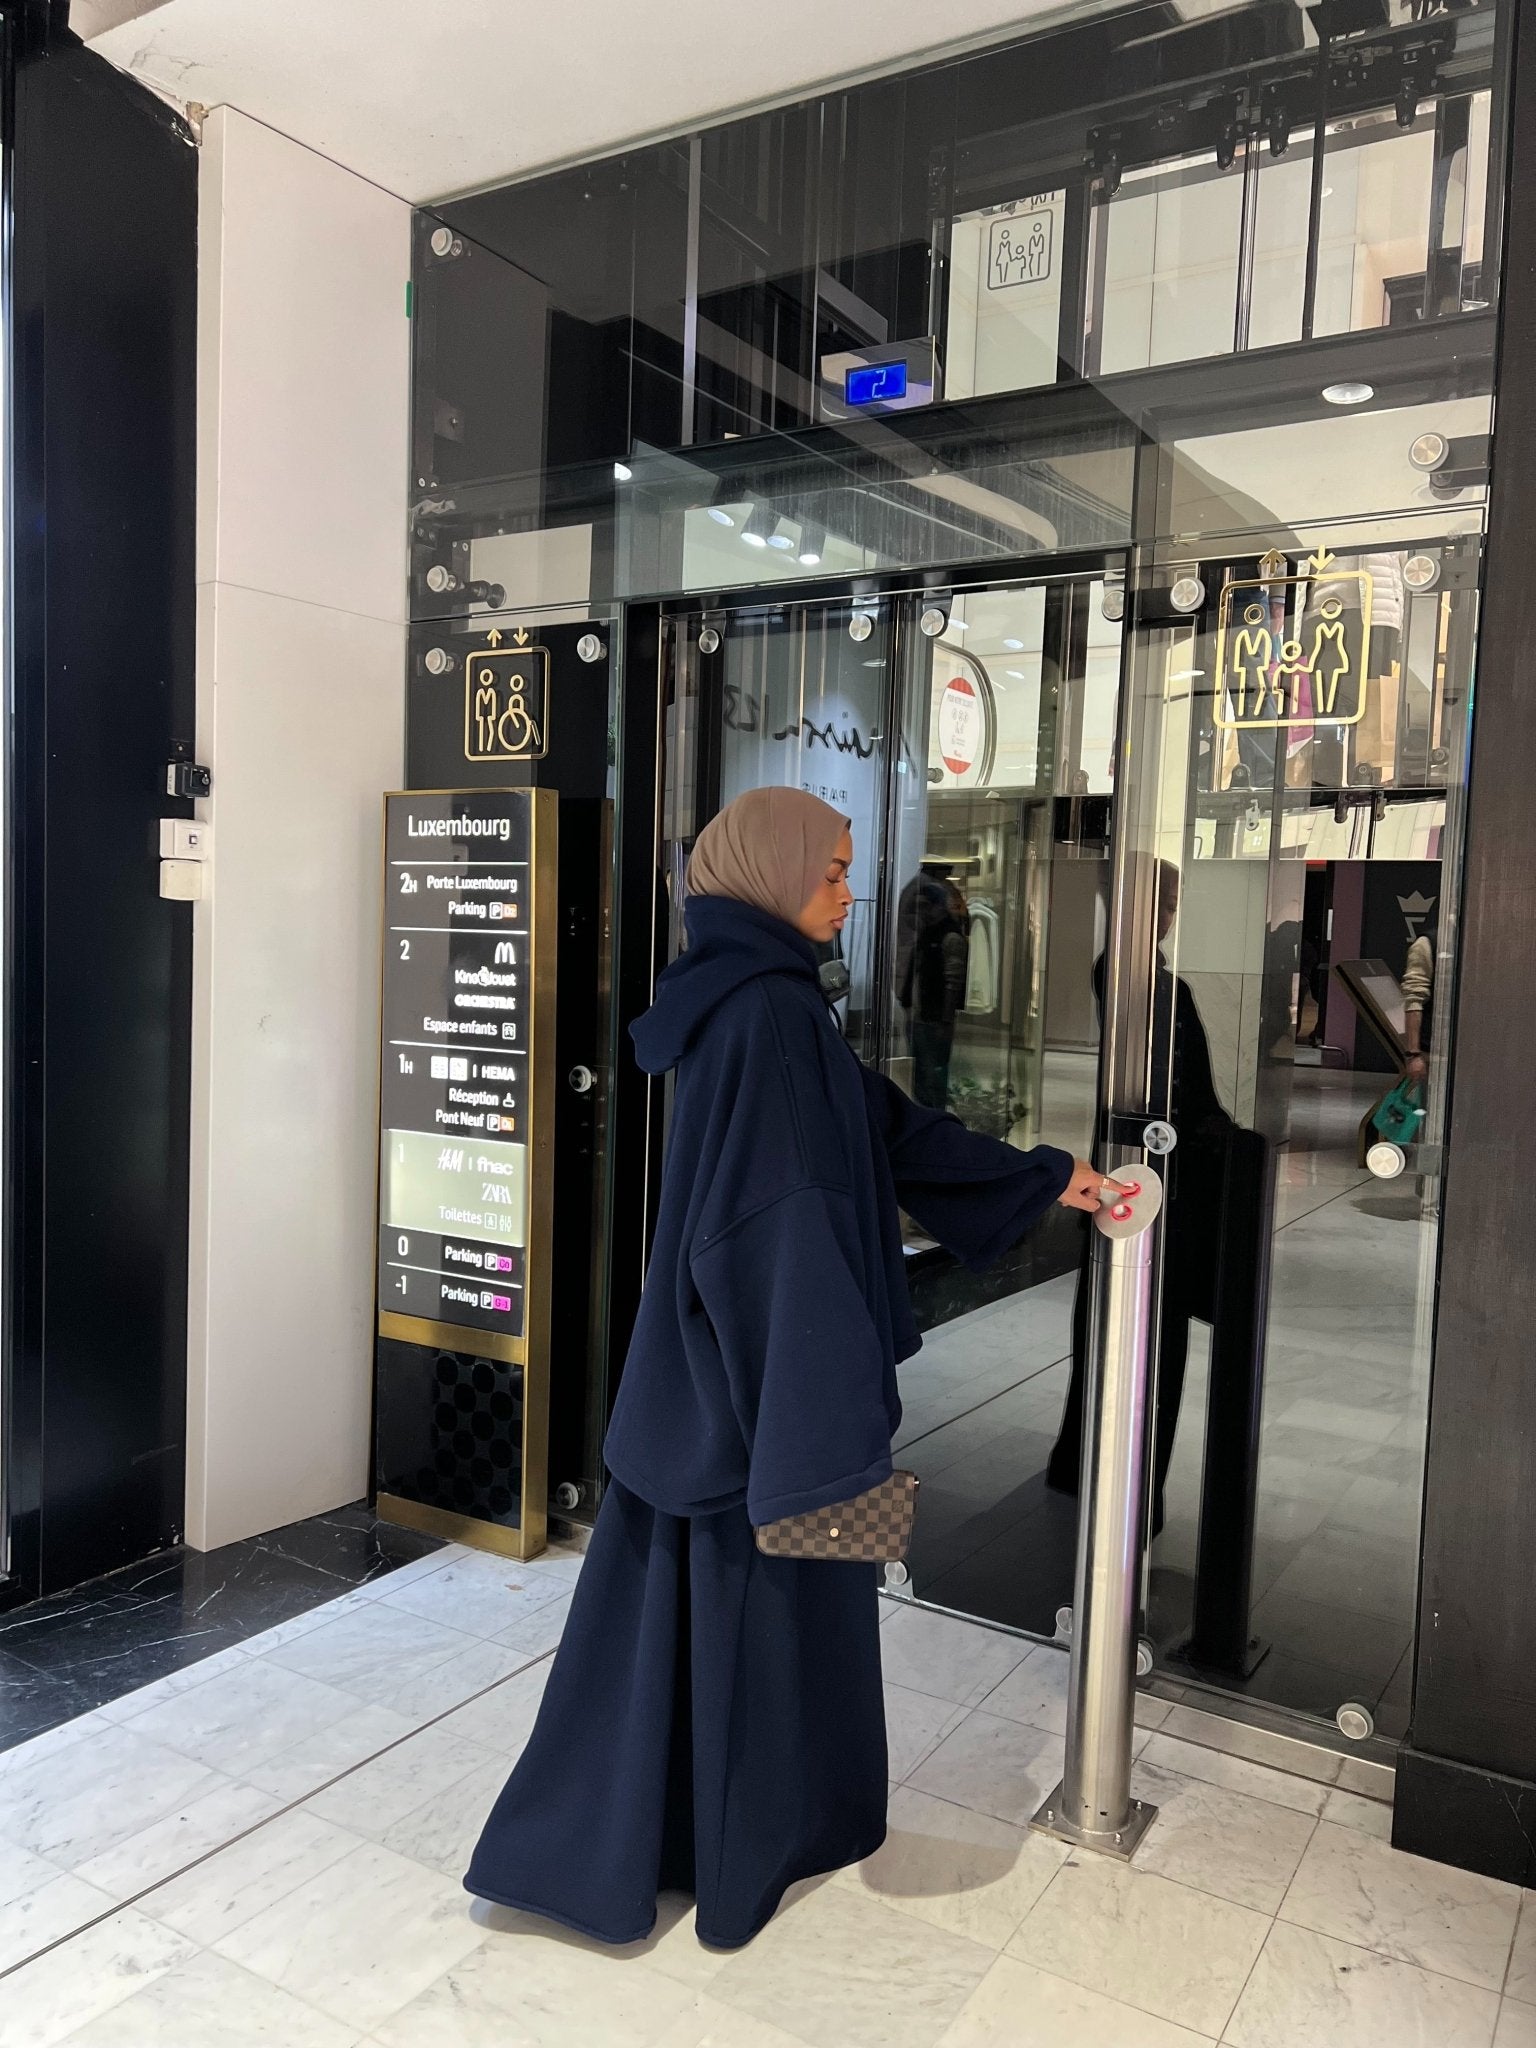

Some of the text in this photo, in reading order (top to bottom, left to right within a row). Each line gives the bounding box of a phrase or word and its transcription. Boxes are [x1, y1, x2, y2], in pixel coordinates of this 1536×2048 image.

[871, 368, 887, 400] 2
[408, 815, 511, 841] Luxembourg
[426, 876, 518, 893] Porte Luxembourg
[448, 901, 486, 918] Parking
[400, 939, 410, 960] 2
[423, 1017, 497, 1036] Espace enfants
[481, 1067, 515, 1081] HEMA
[449, 1088, 499, 1107] Réception
[436, 1109, 459, 1124] Pont
[460, 1112, 484, 1128] Neuf
[398, 1143, 405, 1163] 1
[437, 1148, 514, 1175] H&M fnac
[481, 1182, 512, 1204] ZARA
[439, 1206, 482, 1225] Toilettes
[397, 1236, 409, 1256] 0
[444, 1245, 483, 1268] Parking
[395, 1275, 407, 1295] -1
[441, 1285, 478, 1307] Parking
